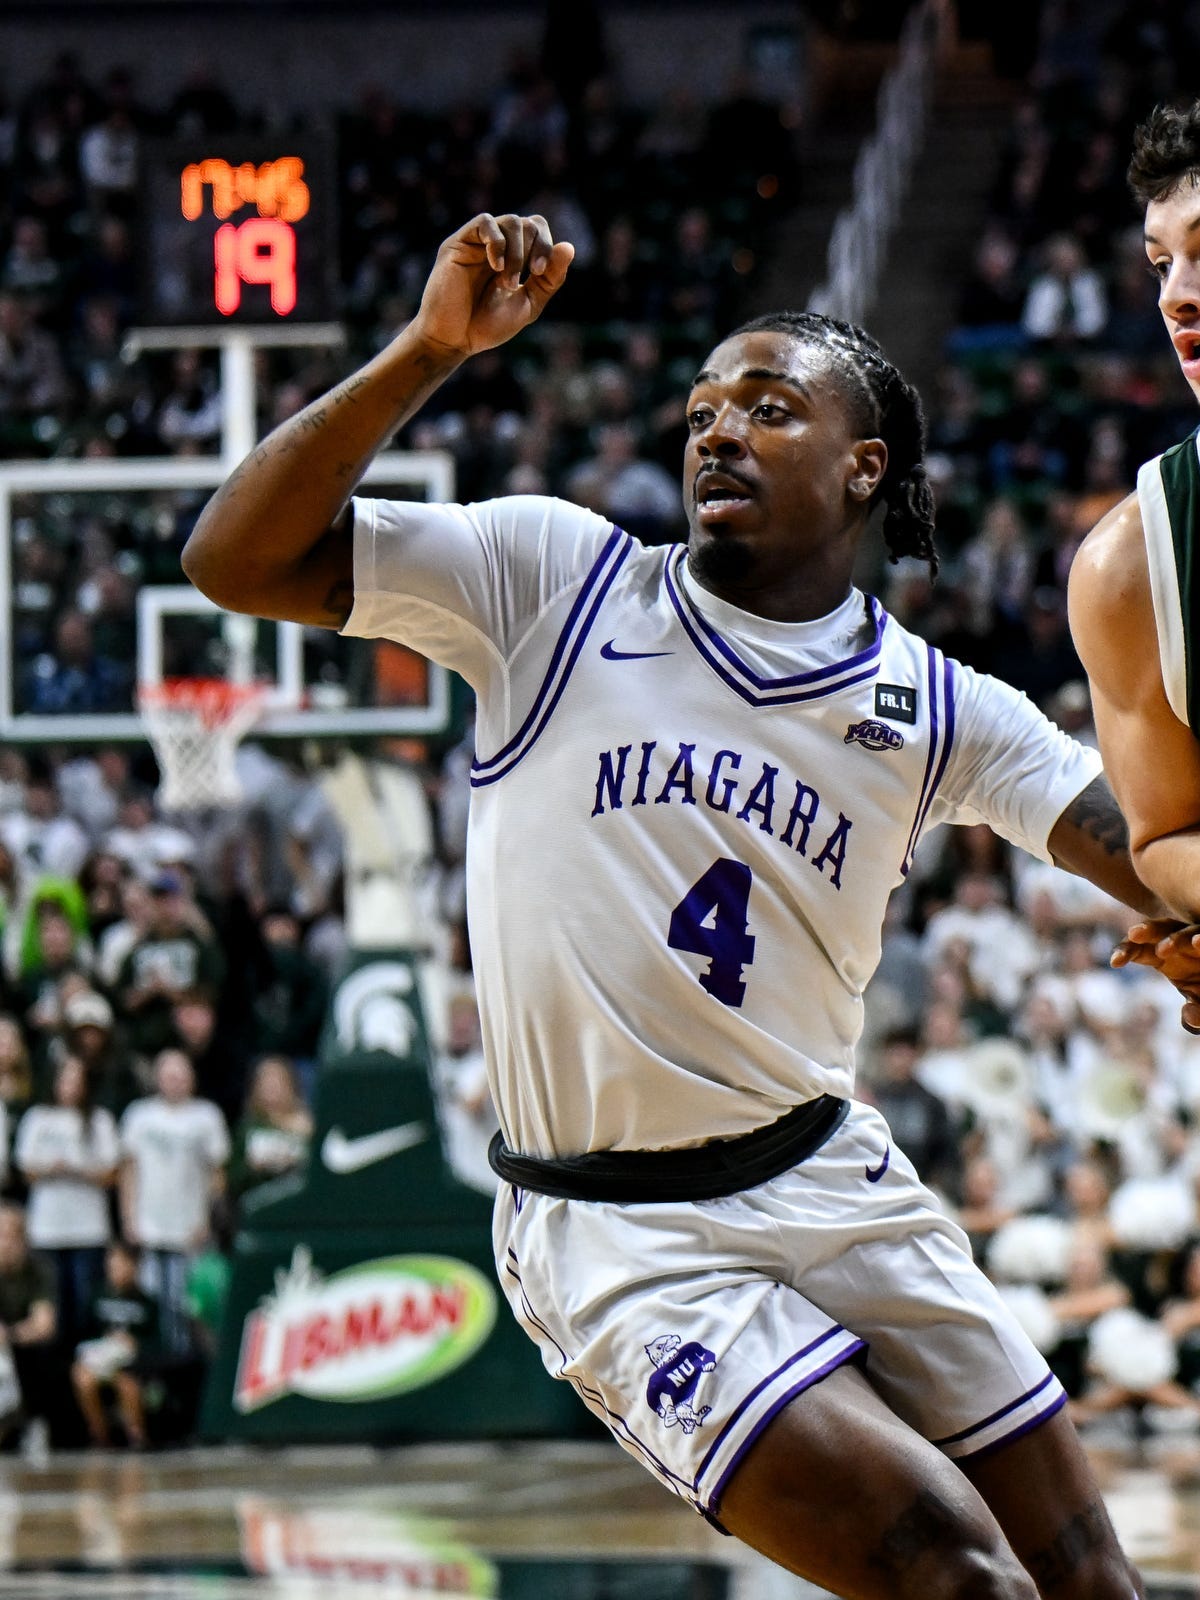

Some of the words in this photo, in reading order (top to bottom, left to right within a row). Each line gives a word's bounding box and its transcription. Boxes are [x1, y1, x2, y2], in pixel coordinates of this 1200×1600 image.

[214, 218, 297, 316] 19
[844, 723, 904, 751] MAAC
[591, 740, 853, 891] NIAGARA
[667, 857, 756, 1008] 4
[238, 1283, 468, 1402] LIBMAN
[666, 1357, 695, 1388] NU
